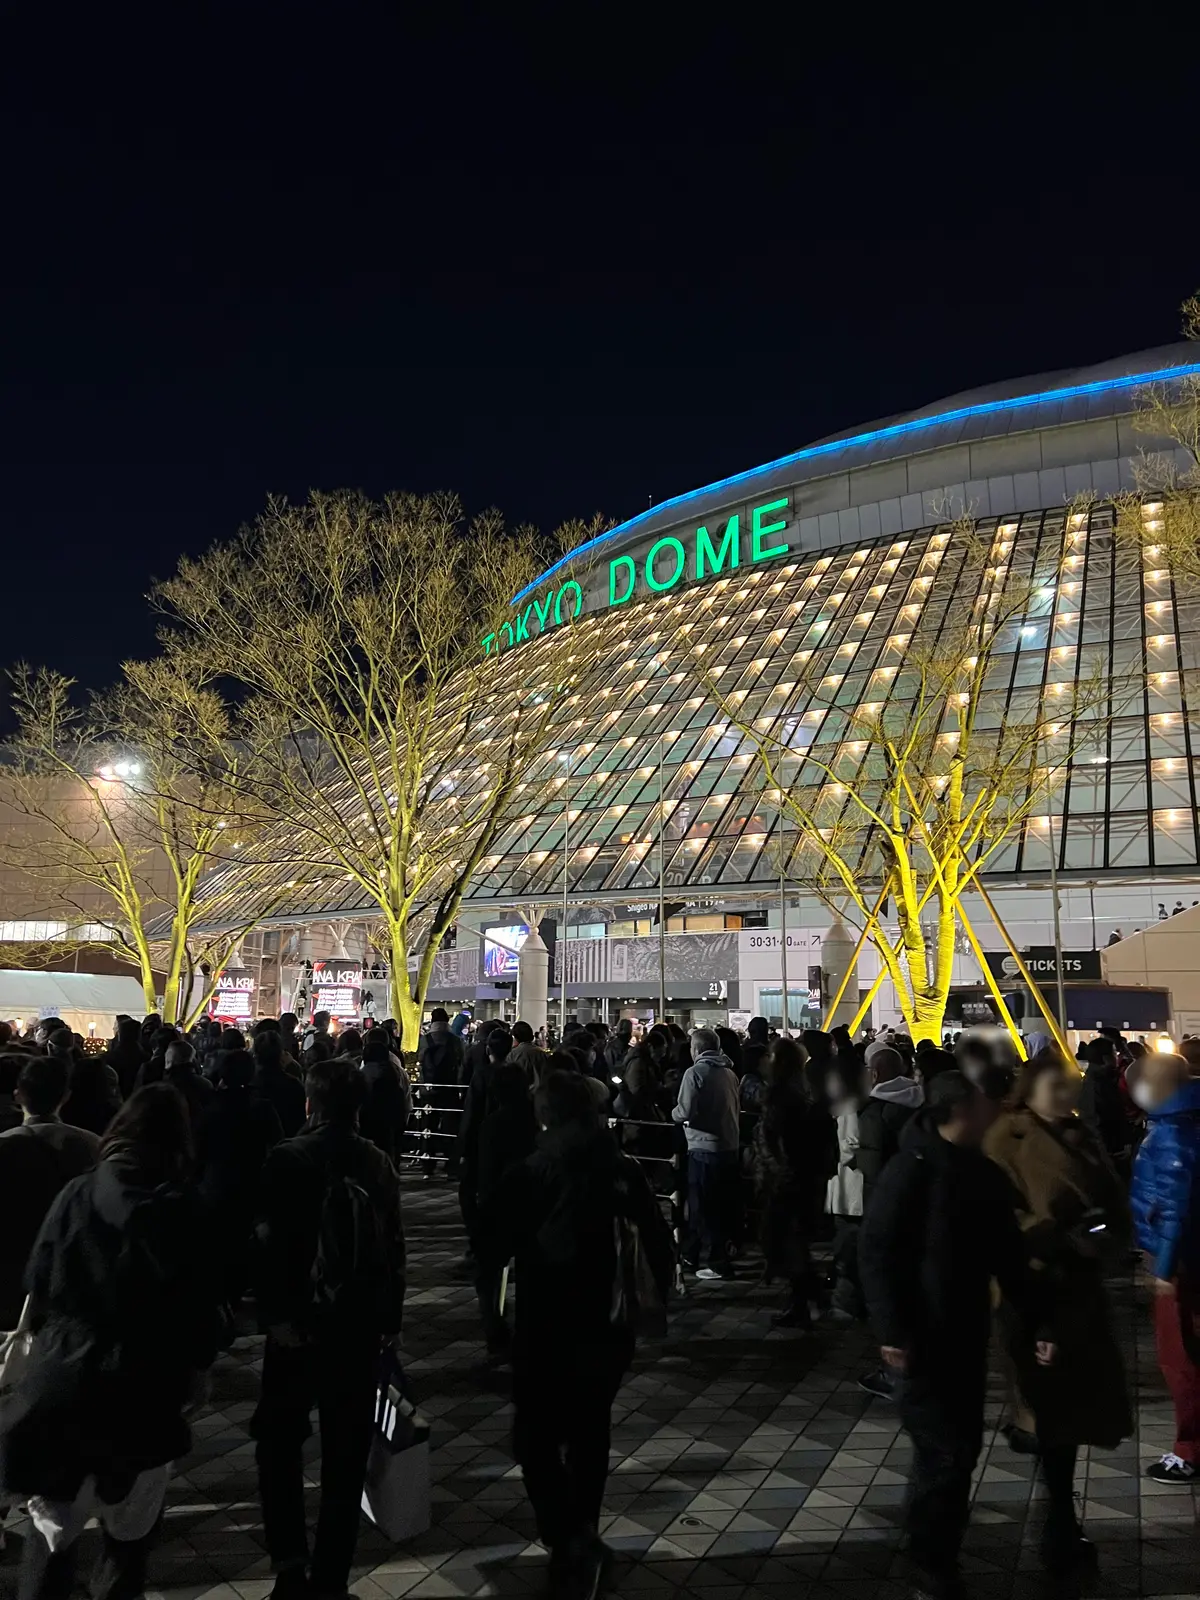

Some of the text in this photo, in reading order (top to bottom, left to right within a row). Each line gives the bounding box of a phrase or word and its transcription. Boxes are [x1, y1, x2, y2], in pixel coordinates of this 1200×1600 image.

[481, 497, 789, 654] TOKYO DOME
[749, 936, 793, 947] 30·31·0
[709, 982, 718, 991] 21
